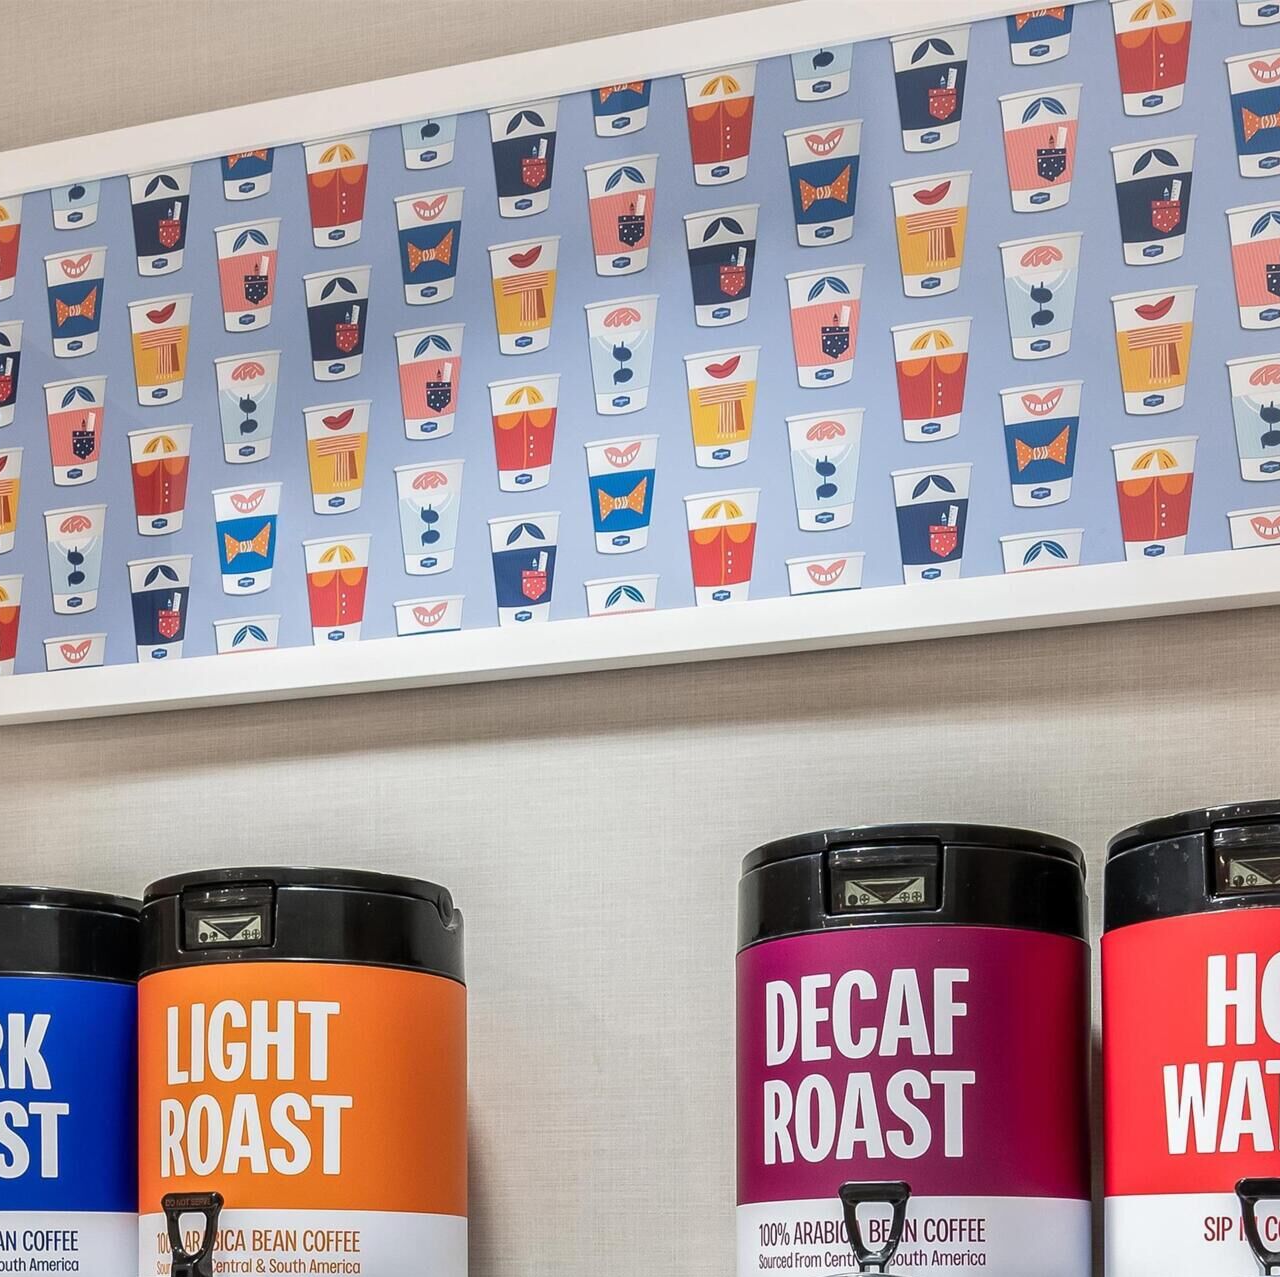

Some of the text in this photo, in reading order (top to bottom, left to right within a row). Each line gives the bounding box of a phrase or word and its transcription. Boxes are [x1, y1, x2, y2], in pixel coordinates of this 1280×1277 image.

[765, 968, 970, 1067] DECAF
[166, 1000, 340, 1084] LIGHT
[763, 1070, 976, 1166] ROAST
[160, 1092, 353, 1178] ROAST
[23, 1230, 79, 1251] COFFEE
[759, 1218, 986, 1247] 100% ARABIC BEN COFFEE
[1204, 1216, 1232, 1241] SIP
[157, 1229, 360, 1254] 100 ARBICA BEAN COFFEE
[29, 1257, 79, 1272] America
[157, 1257, 361, 1275] Sour Central & South America
[759, 1251, 793, 1269] Sourced
[795, 1252, 822, 1268] From
[824, 1251, 856, 1267] Centr
[931, 1249, 987, 1266] America
